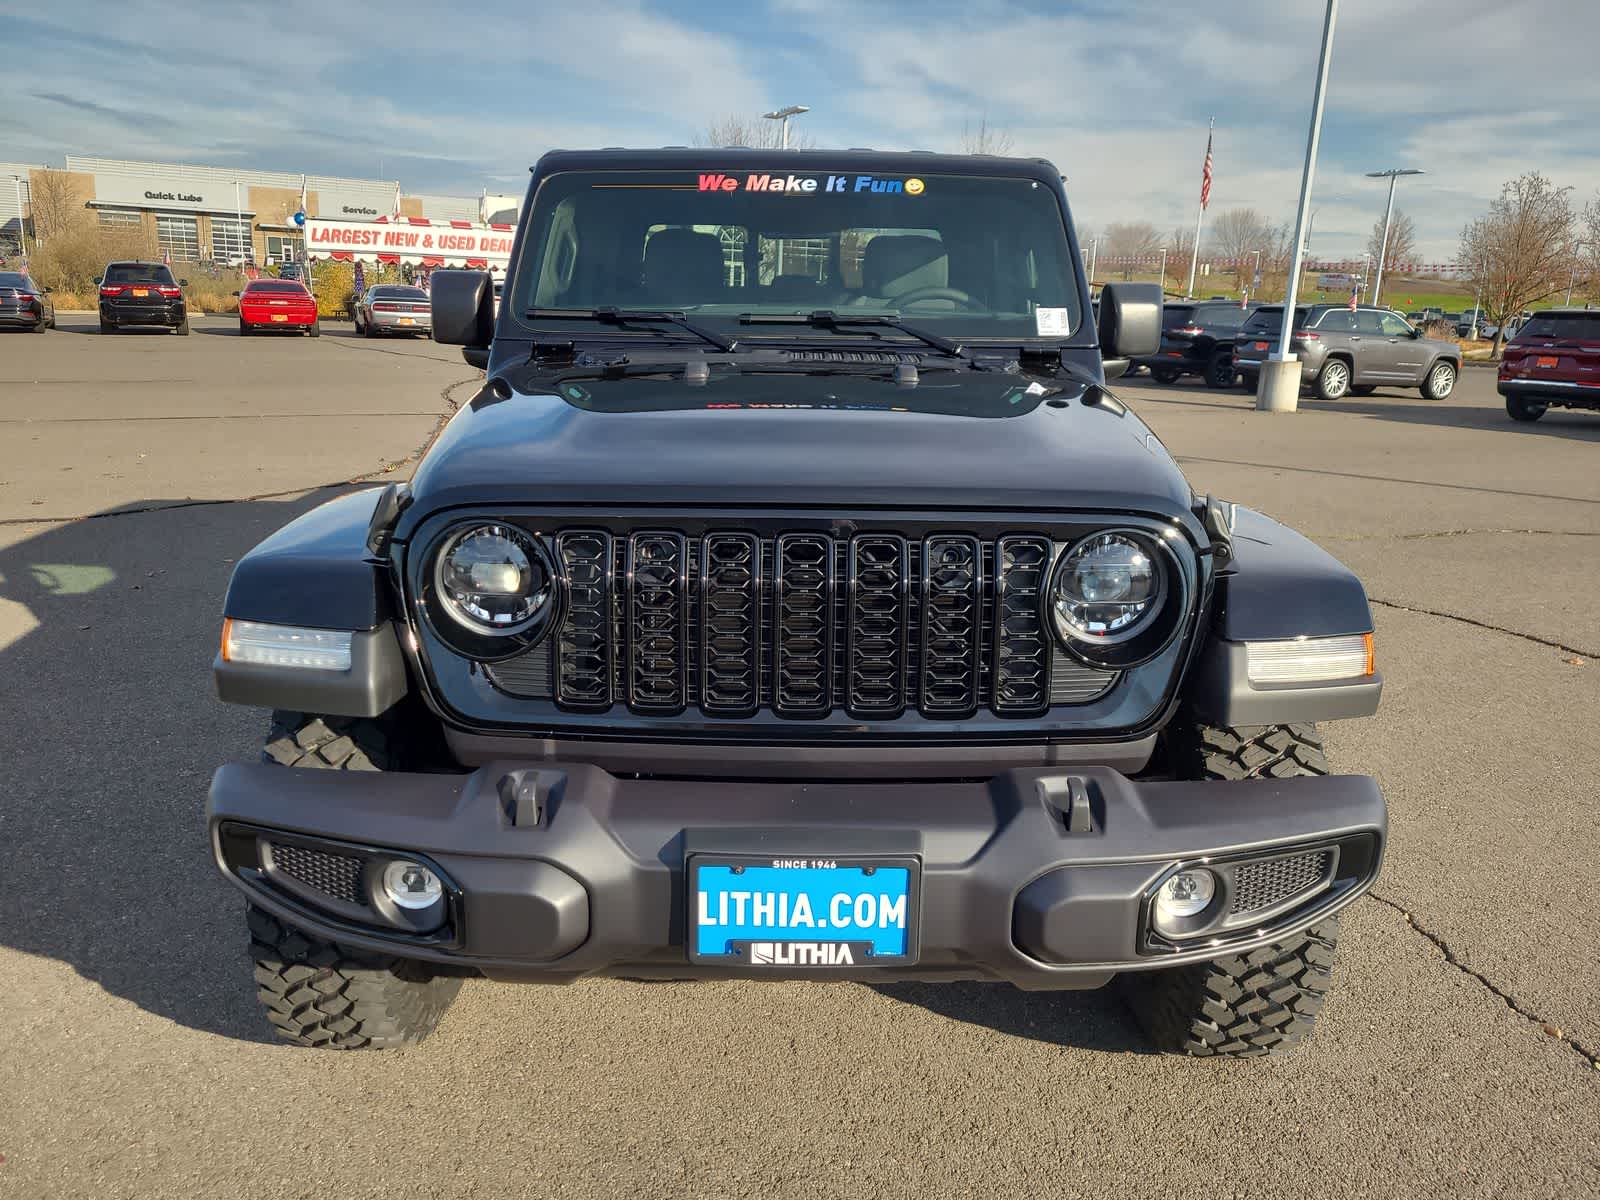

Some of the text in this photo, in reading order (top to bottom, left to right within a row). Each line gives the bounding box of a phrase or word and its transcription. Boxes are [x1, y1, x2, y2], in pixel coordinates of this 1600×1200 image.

[697, 174, 902, 193] We Make It Fun
[144, 191, 203, 202] Quick Lube
[342, 206, 377, 215] Service
[311, 227, 381, 246] LARGEST
[384, 231, 419, 248] NEW
[422, 233, 434, 248] &
[438, 234, 475, 250] USED
[772, 860, 837, 869] SINCE 1946
[698, 891, 906, 928] LITHIA.COM
[774, 943, 854, 964] LITHIA
